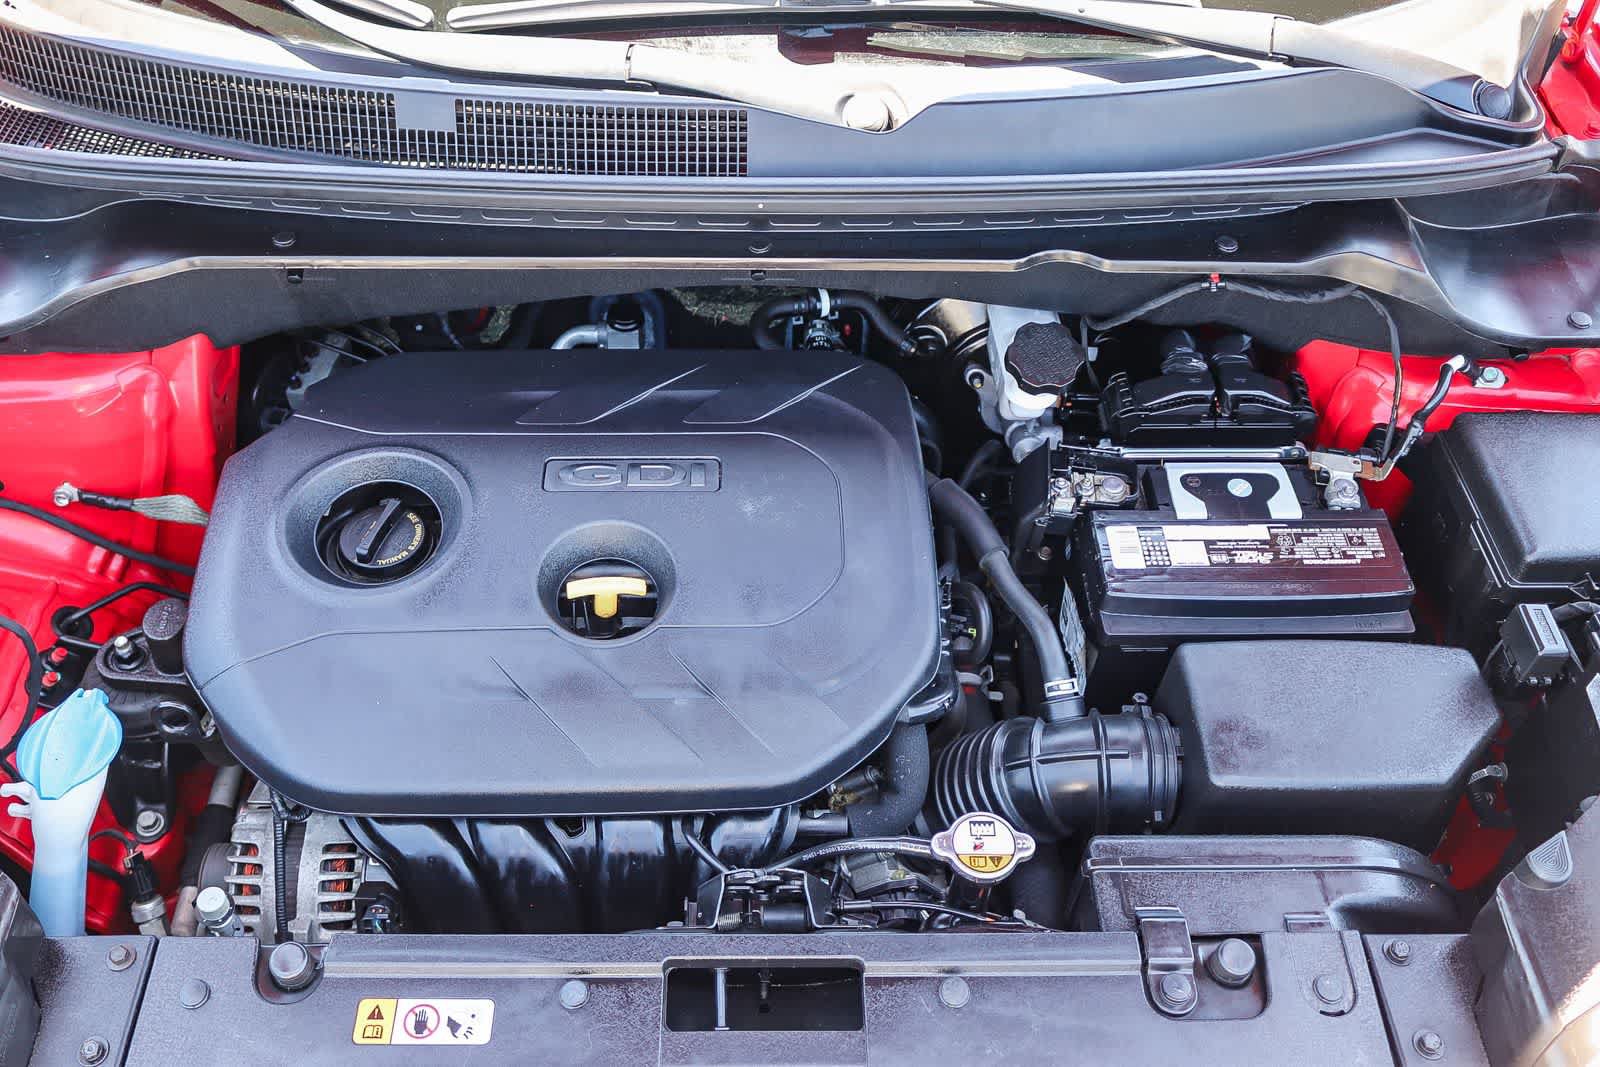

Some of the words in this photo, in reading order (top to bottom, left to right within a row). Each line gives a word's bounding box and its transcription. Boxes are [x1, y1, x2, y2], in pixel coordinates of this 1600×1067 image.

[558, 462, 706, 487] GDI
[407, 513, 420, 524] SEE
[376, 551, 408, 565] MANUAL
